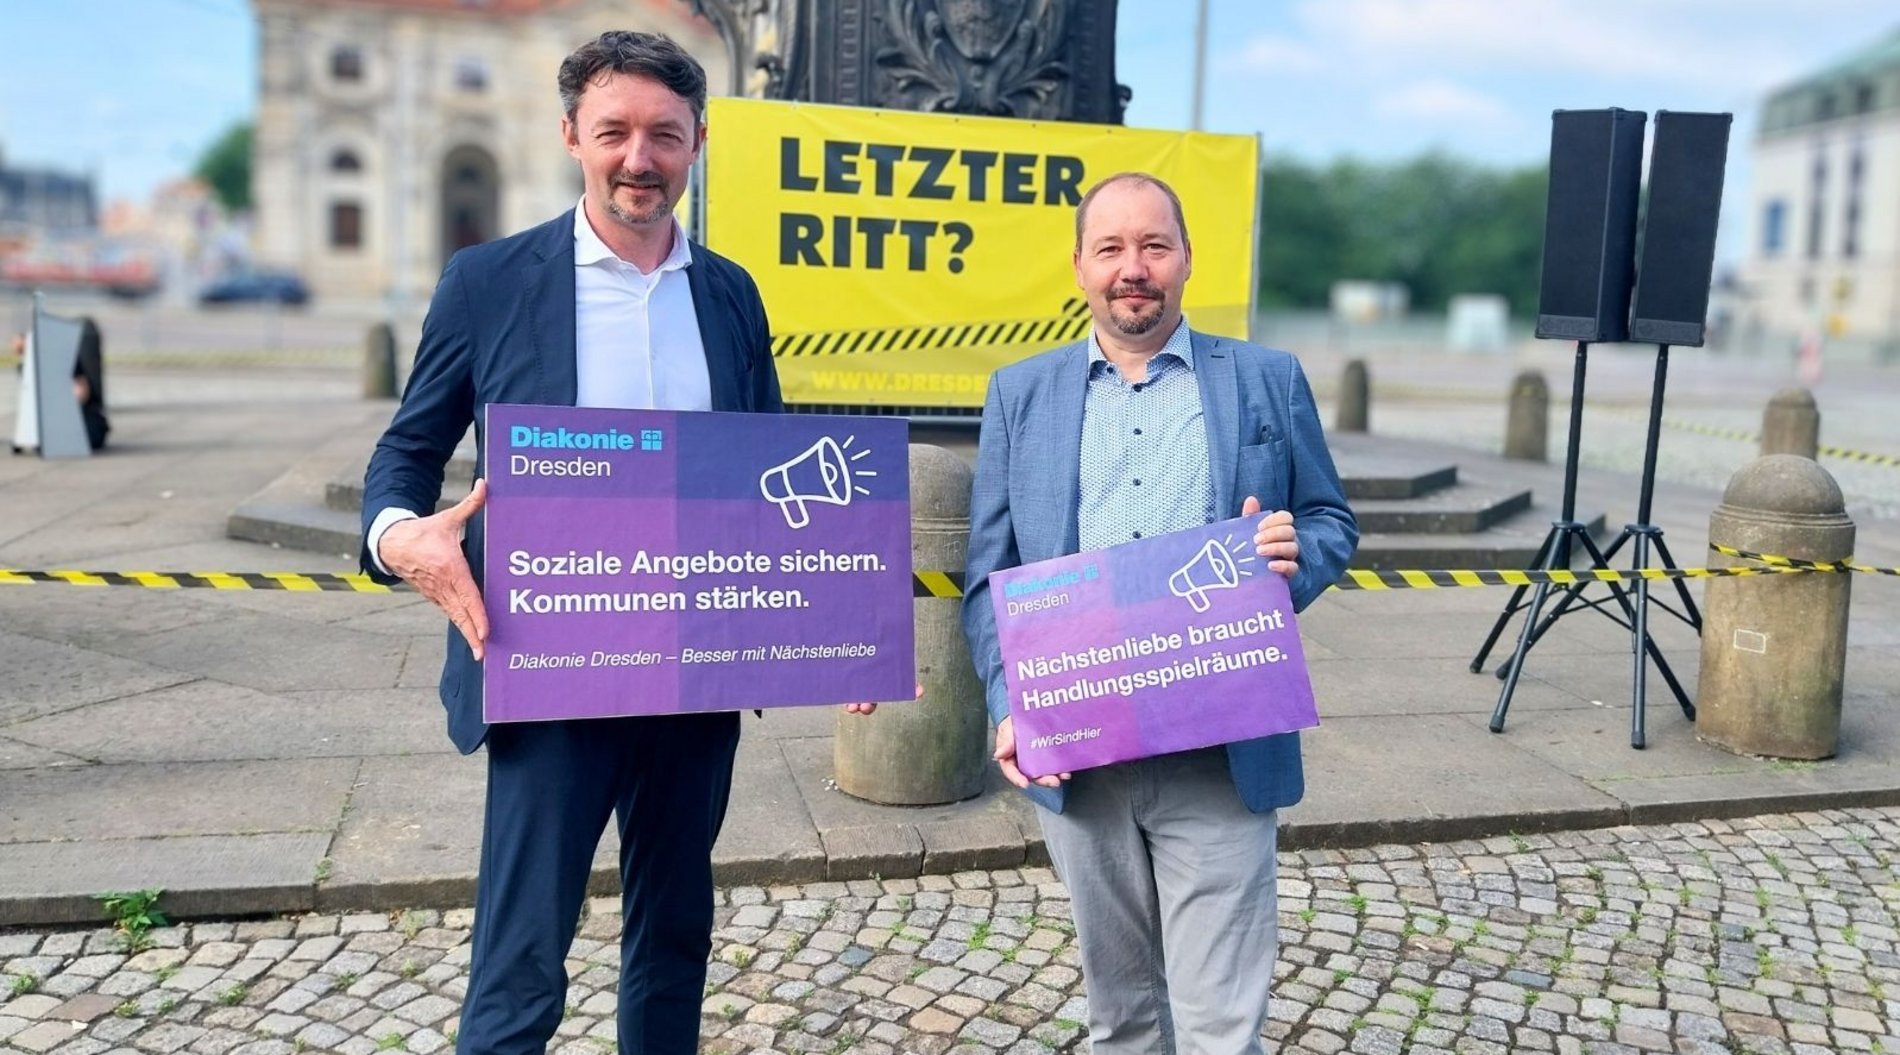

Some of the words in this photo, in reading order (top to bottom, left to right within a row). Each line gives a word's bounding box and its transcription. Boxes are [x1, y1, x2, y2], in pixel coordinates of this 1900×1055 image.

[780, 136, 1084, 206] LETZTER
[779, 212, 974, 274] RITT?
[511, 425, 634, 450] Diakonie
[510, 455, 611, 477] Dresden
[508, 550, 621, 577] Soziale
[630, 551, 771, 579] Angebote
[779, 549, 887, 573] sichern.
[509, 589, 686, 614] Kommunen
[695, 586, 809, 610] stärken.
[1007, 592, 1070, 617] Dresden
[509, 653, 586, 670] Diakonie
[590, 650, 661, 667] Dresden
[681, 648, 738, 663] Besser
[741, 646, 766, 661] mit
[770, 642, 876, 660] Nächstenliebe
[1017, 634, 1183, 681] Nächstenliebe
[1188, 608, 1284, 647] braucht
[1022, 646, 1288, 711] Handlungsspielräume.
[1030, 727, 1102, 749] #WirSindHier
